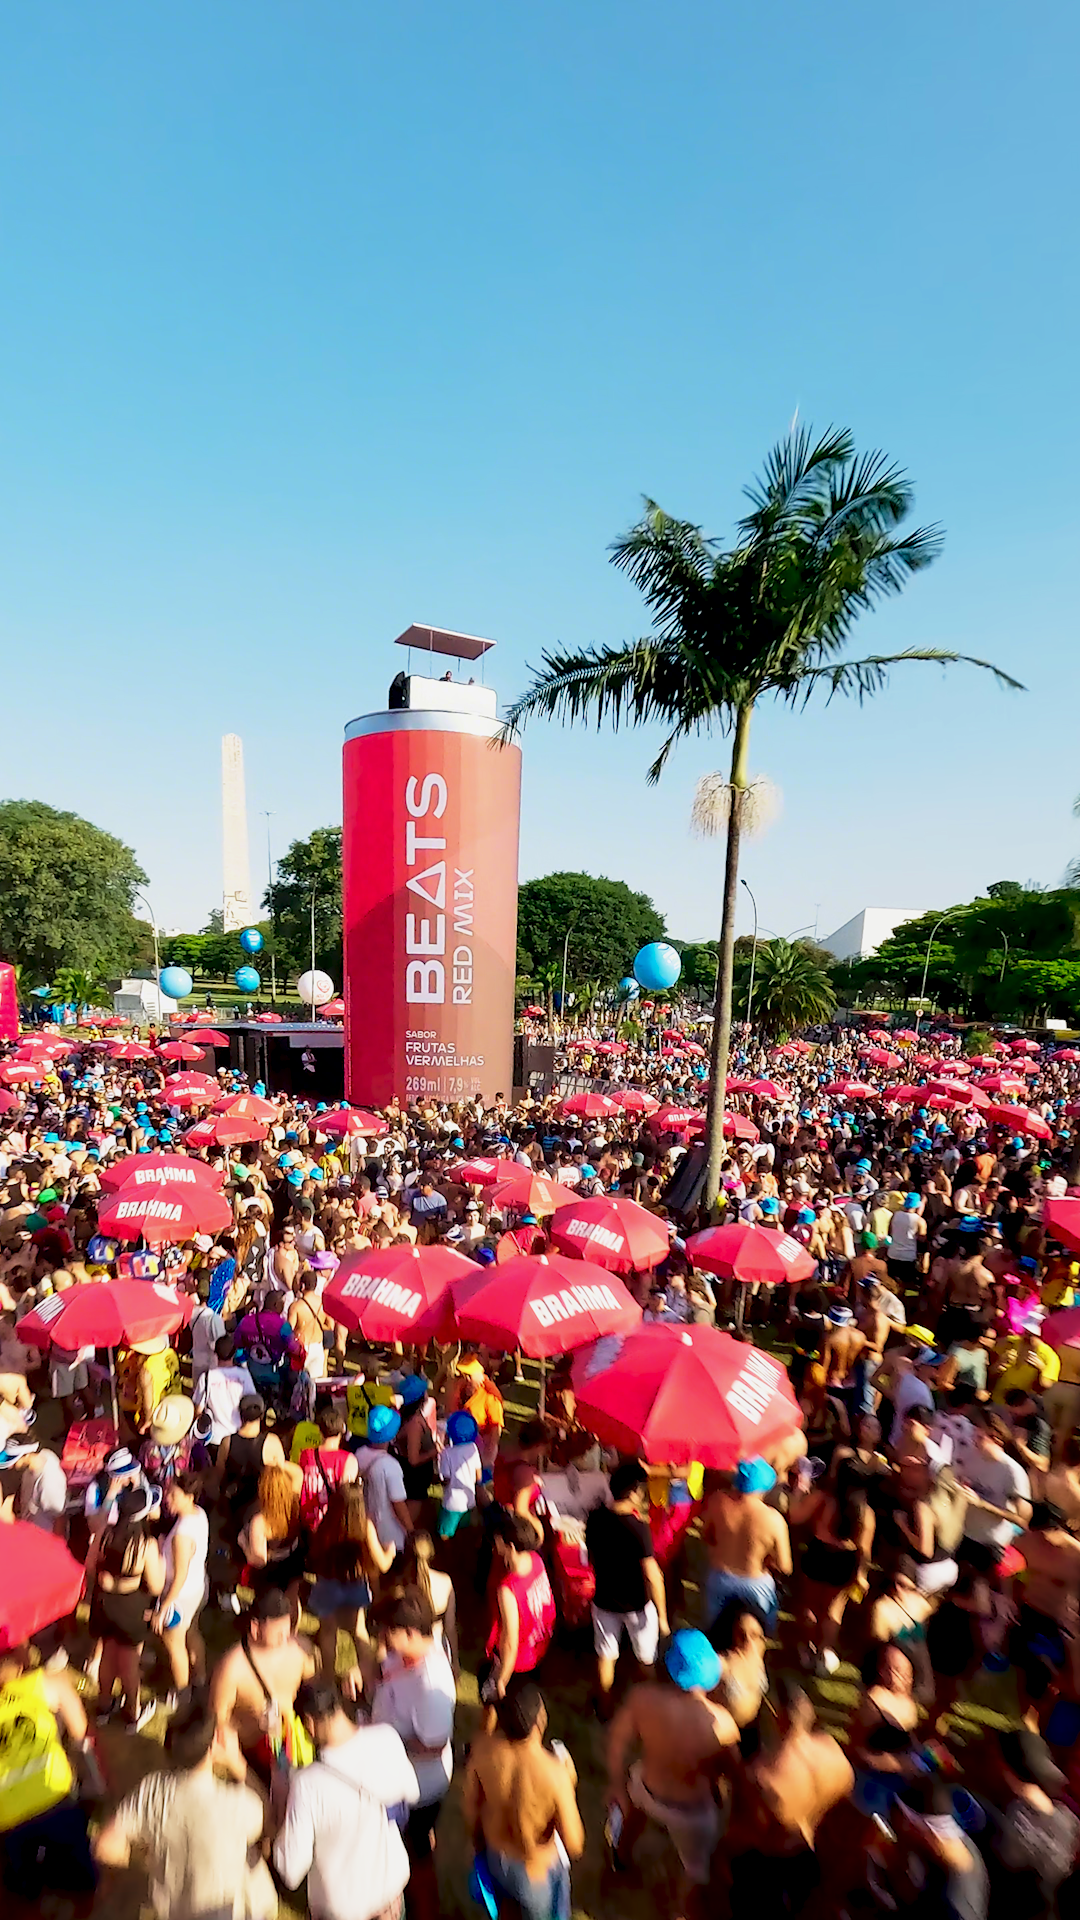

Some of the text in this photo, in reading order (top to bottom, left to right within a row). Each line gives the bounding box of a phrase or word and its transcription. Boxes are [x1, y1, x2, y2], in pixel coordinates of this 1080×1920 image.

[405, 772, 448, 1005] BEATS
[452, 868, 474, 1005] RED MIX
[405, 1030, 437, 1039] SABOR
[405, 1042, 456, 1053] FRUTAS
[405, 1055, 485, 1066] VERMELHAS
[405, 1076, 440, 1091] 269ml
[134, 1166, 196, 1185] BRAHMA
[116, 1200, 183, 1221] BRAHMA
[565, 1219, 625, 1253] BRAHMA
[340, 1273, 422, 1319] BRAHMA
[528, 1284, 623, 1328] BRAHMA
